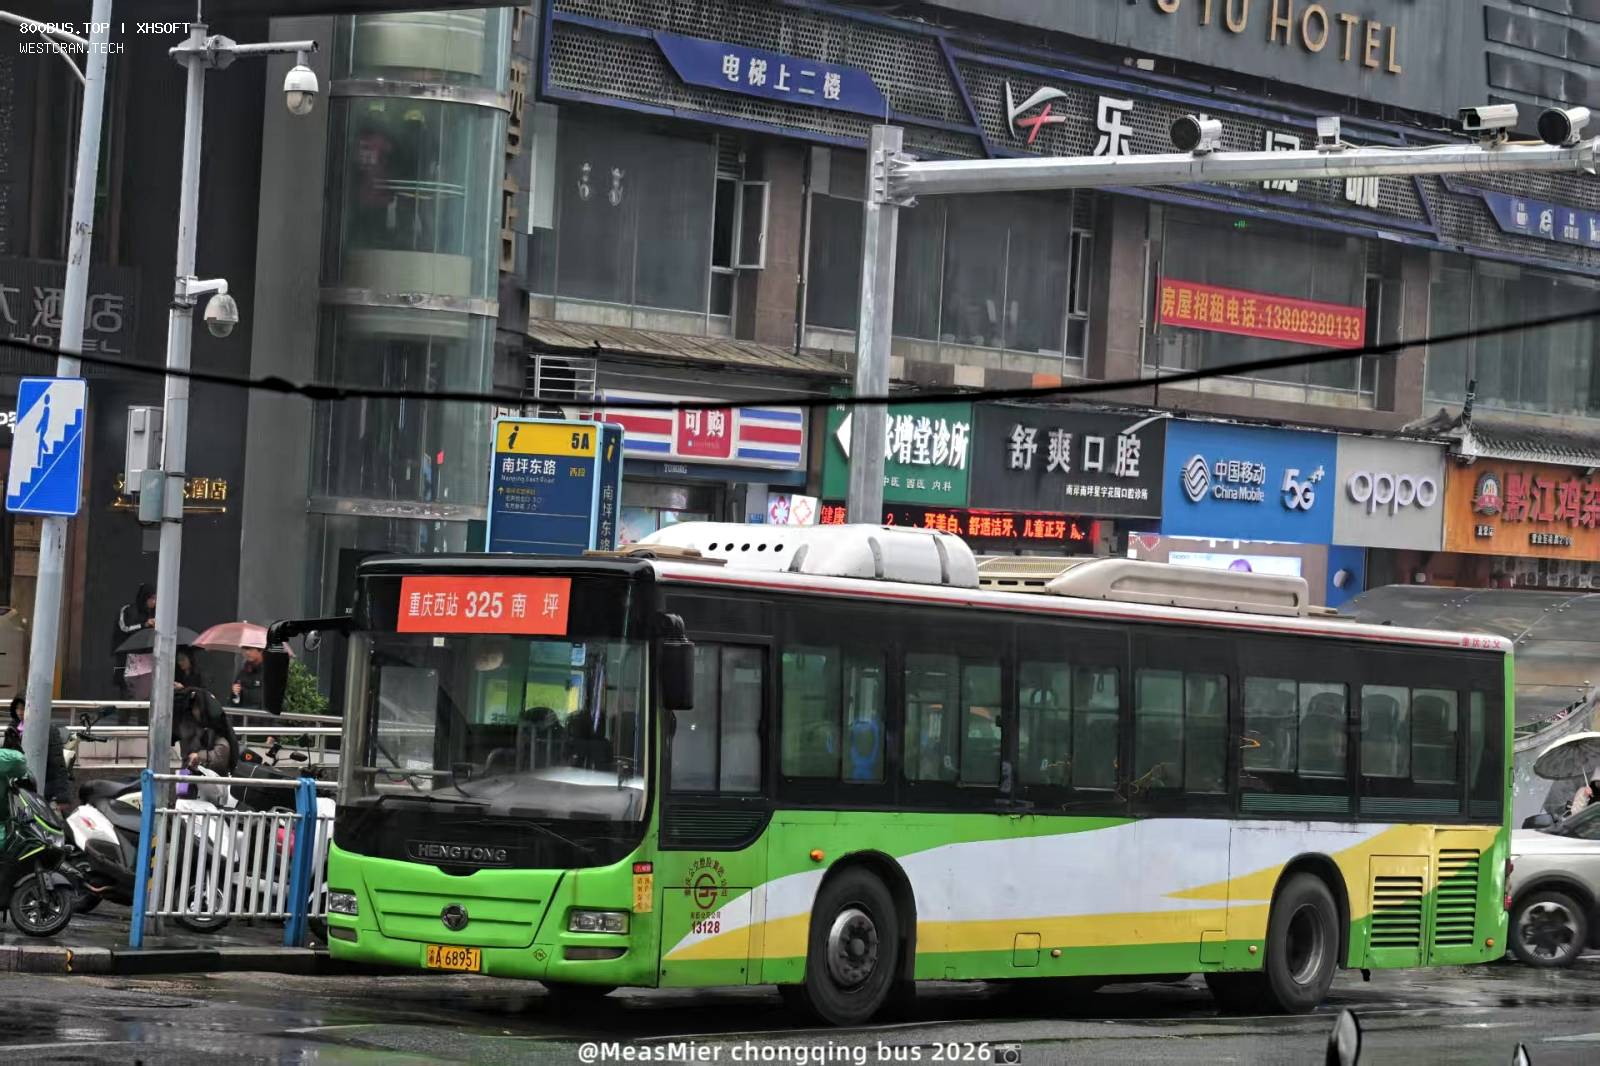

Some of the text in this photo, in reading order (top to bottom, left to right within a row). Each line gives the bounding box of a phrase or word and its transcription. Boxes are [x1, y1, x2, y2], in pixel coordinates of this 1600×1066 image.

[1269, 0, 1402, 74] HOTEL
[721, 53, 842, 101] 电梯上二楼
[571, 432, 590, 450] 5A
[1009, 423, 1141, 478] 舒爽口腔
[502, 457, 556, 476] 南坪东路
[1214, 459, 1267, 485] 中国移动
[1213, 486, 1265, 502] China Mobile
[408, 592, 459, 617] 重庆西站
[465, 591, 503, 618] 325
[418, 844, 508, 861] HENGTONG
[691, 920, 720, 935] 13128
